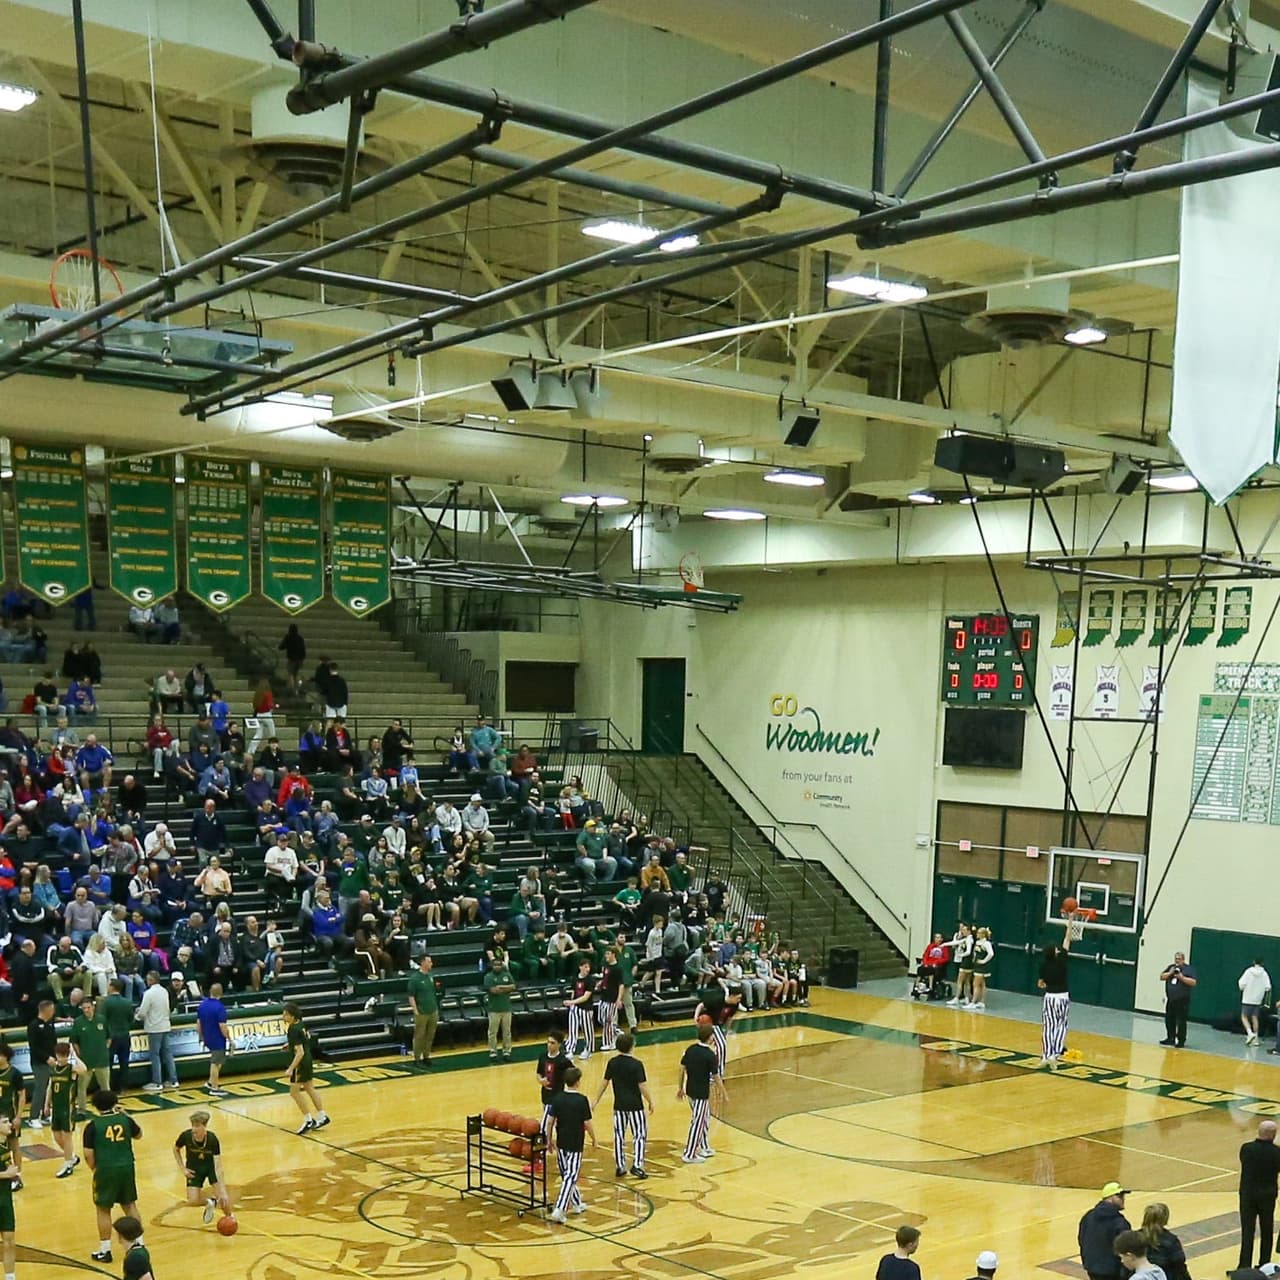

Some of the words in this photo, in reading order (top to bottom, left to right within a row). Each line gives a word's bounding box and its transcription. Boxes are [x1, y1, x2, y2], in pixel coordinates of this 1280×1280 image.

[770, 693, 798, 717] GO
[766, 707, 881, 757] Woodmen!
[782, 768, 801, 780] from
[803, 771, 822, 784] your
[824, 771, 842, 783] fans
[844, 775, 853, 784] at
[227, 1020, 290, 1038] OODMEN
[105, 1125, 125, 1142] 42
